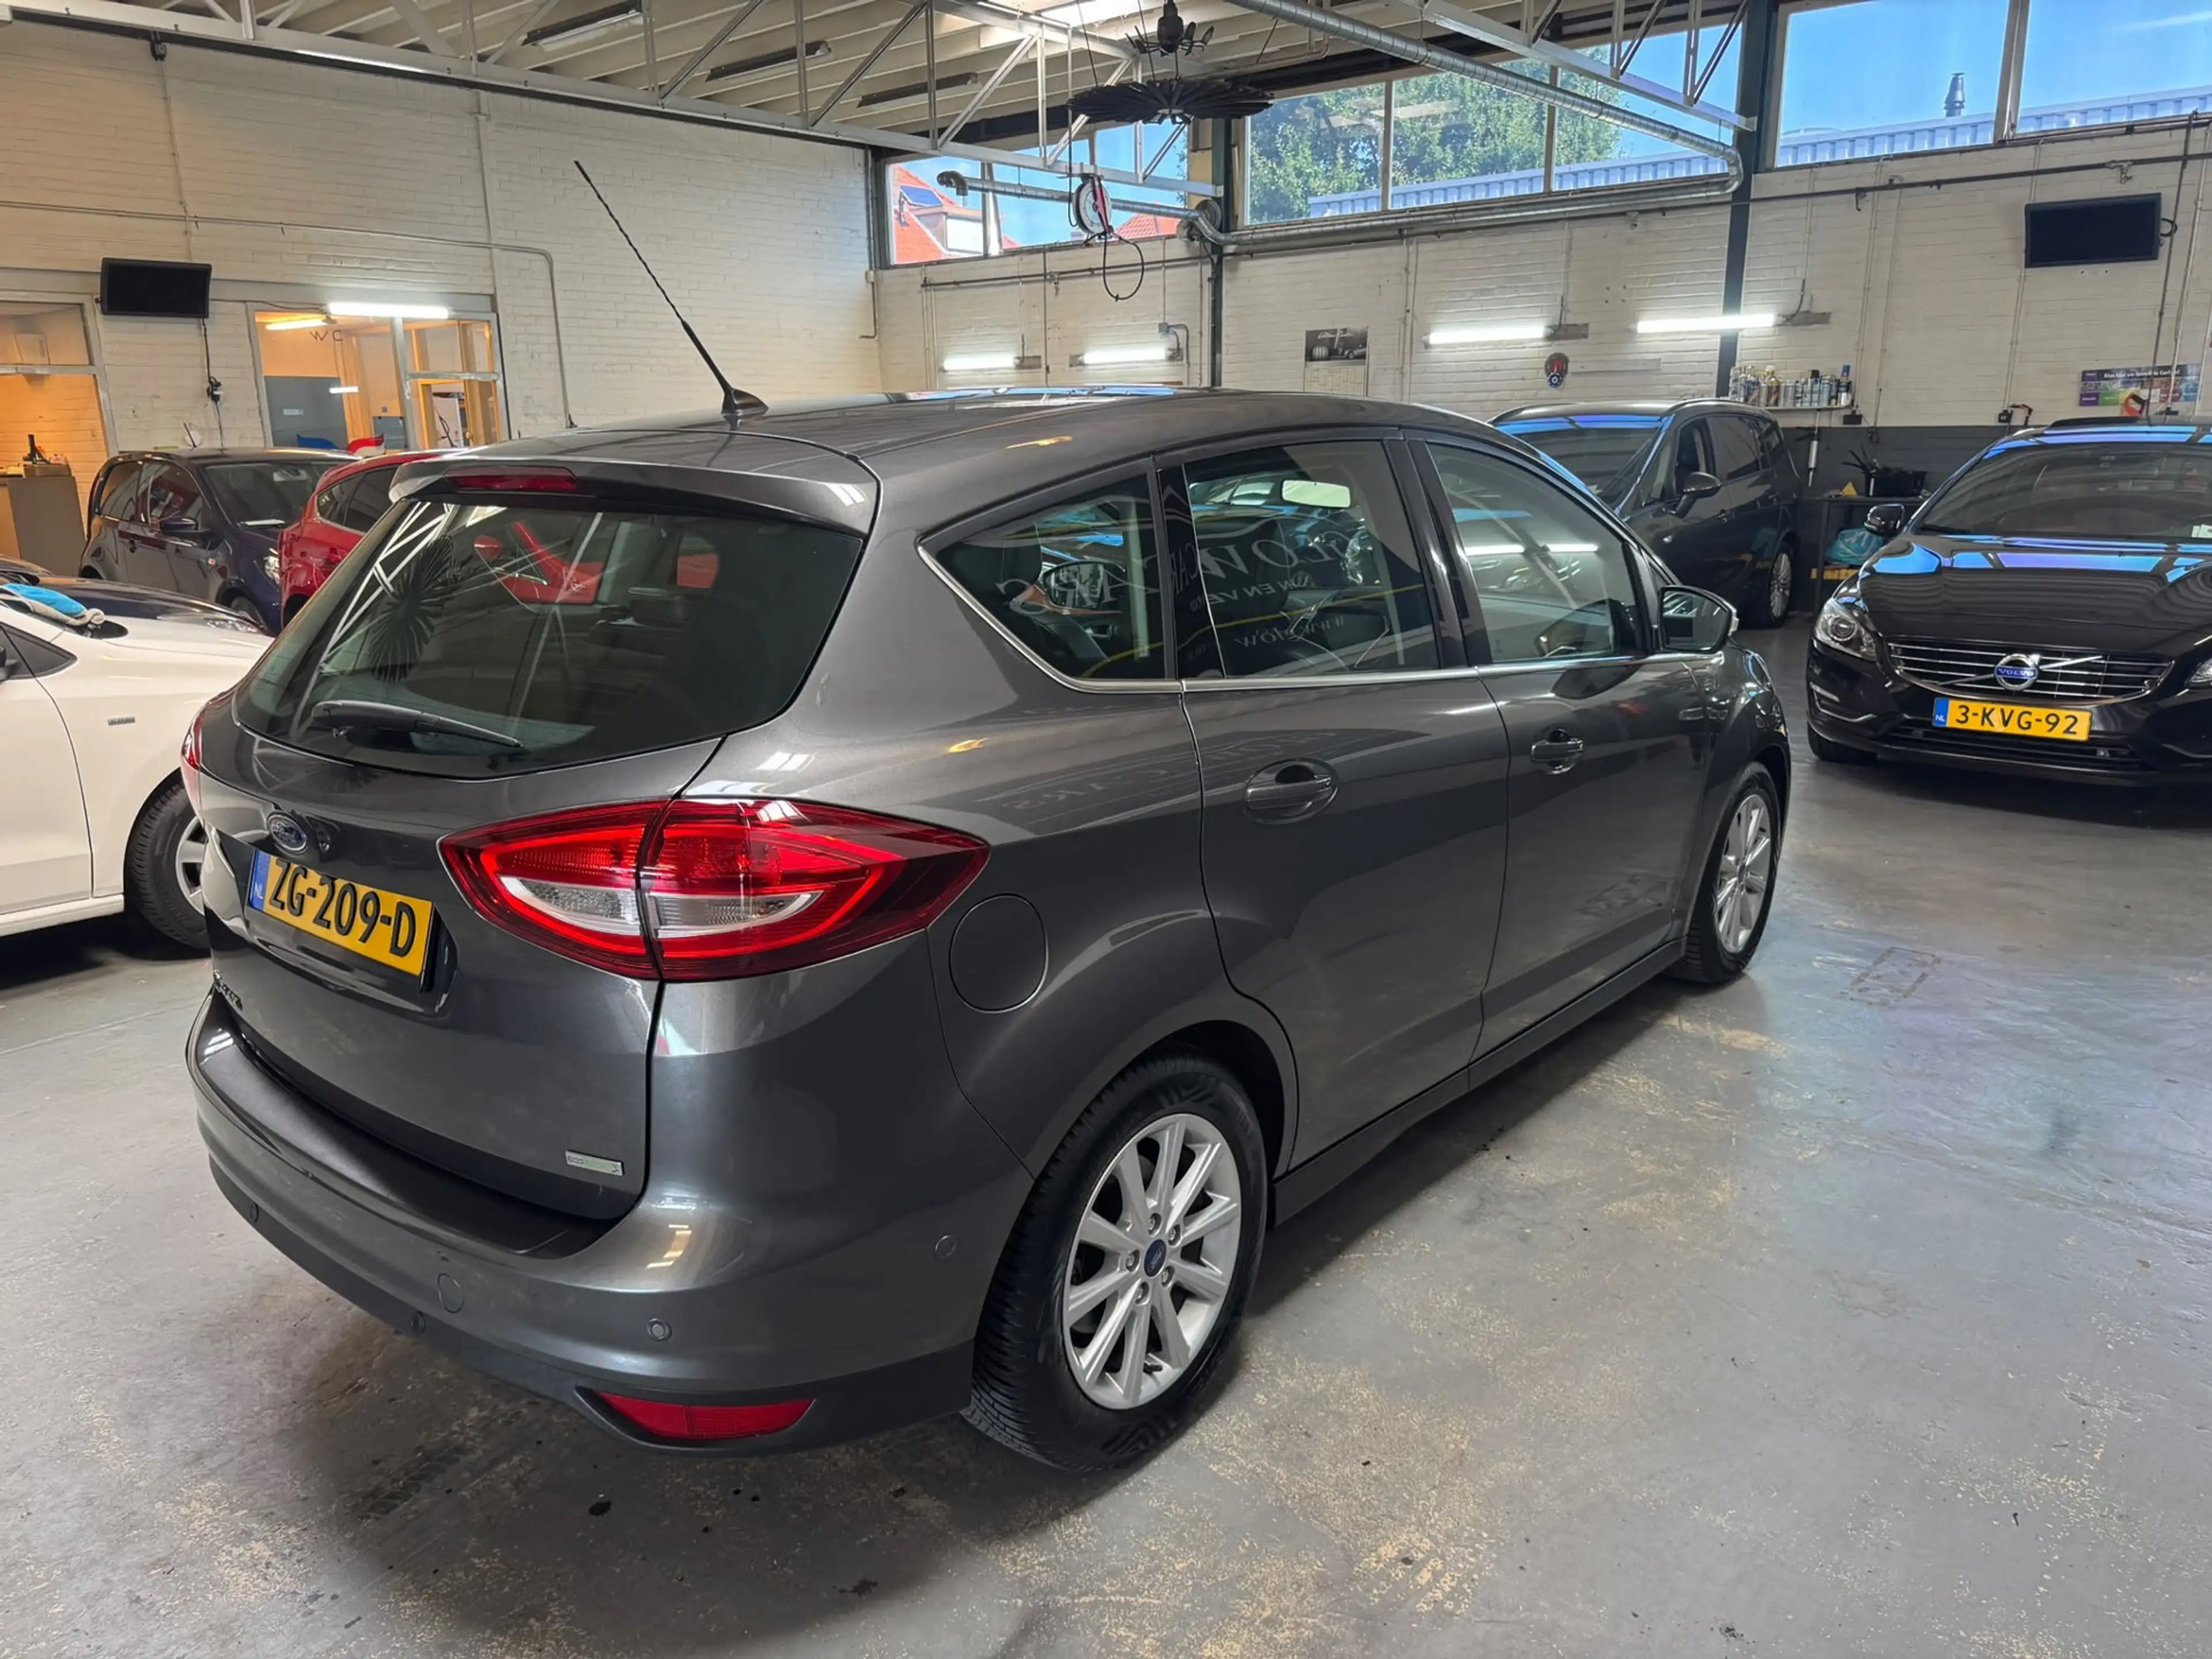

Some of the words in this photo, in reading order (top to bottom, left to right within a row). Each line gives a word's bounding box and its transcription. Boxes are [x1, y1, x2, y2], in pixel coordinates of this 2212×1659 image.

[1997, 667, 2035, 677] VOLVO
[1956, 704, 2079, 736] 3-KVG-92
[254, 886, 263, 900] NL
[269, 858, 416, 958] ZG-209-D
